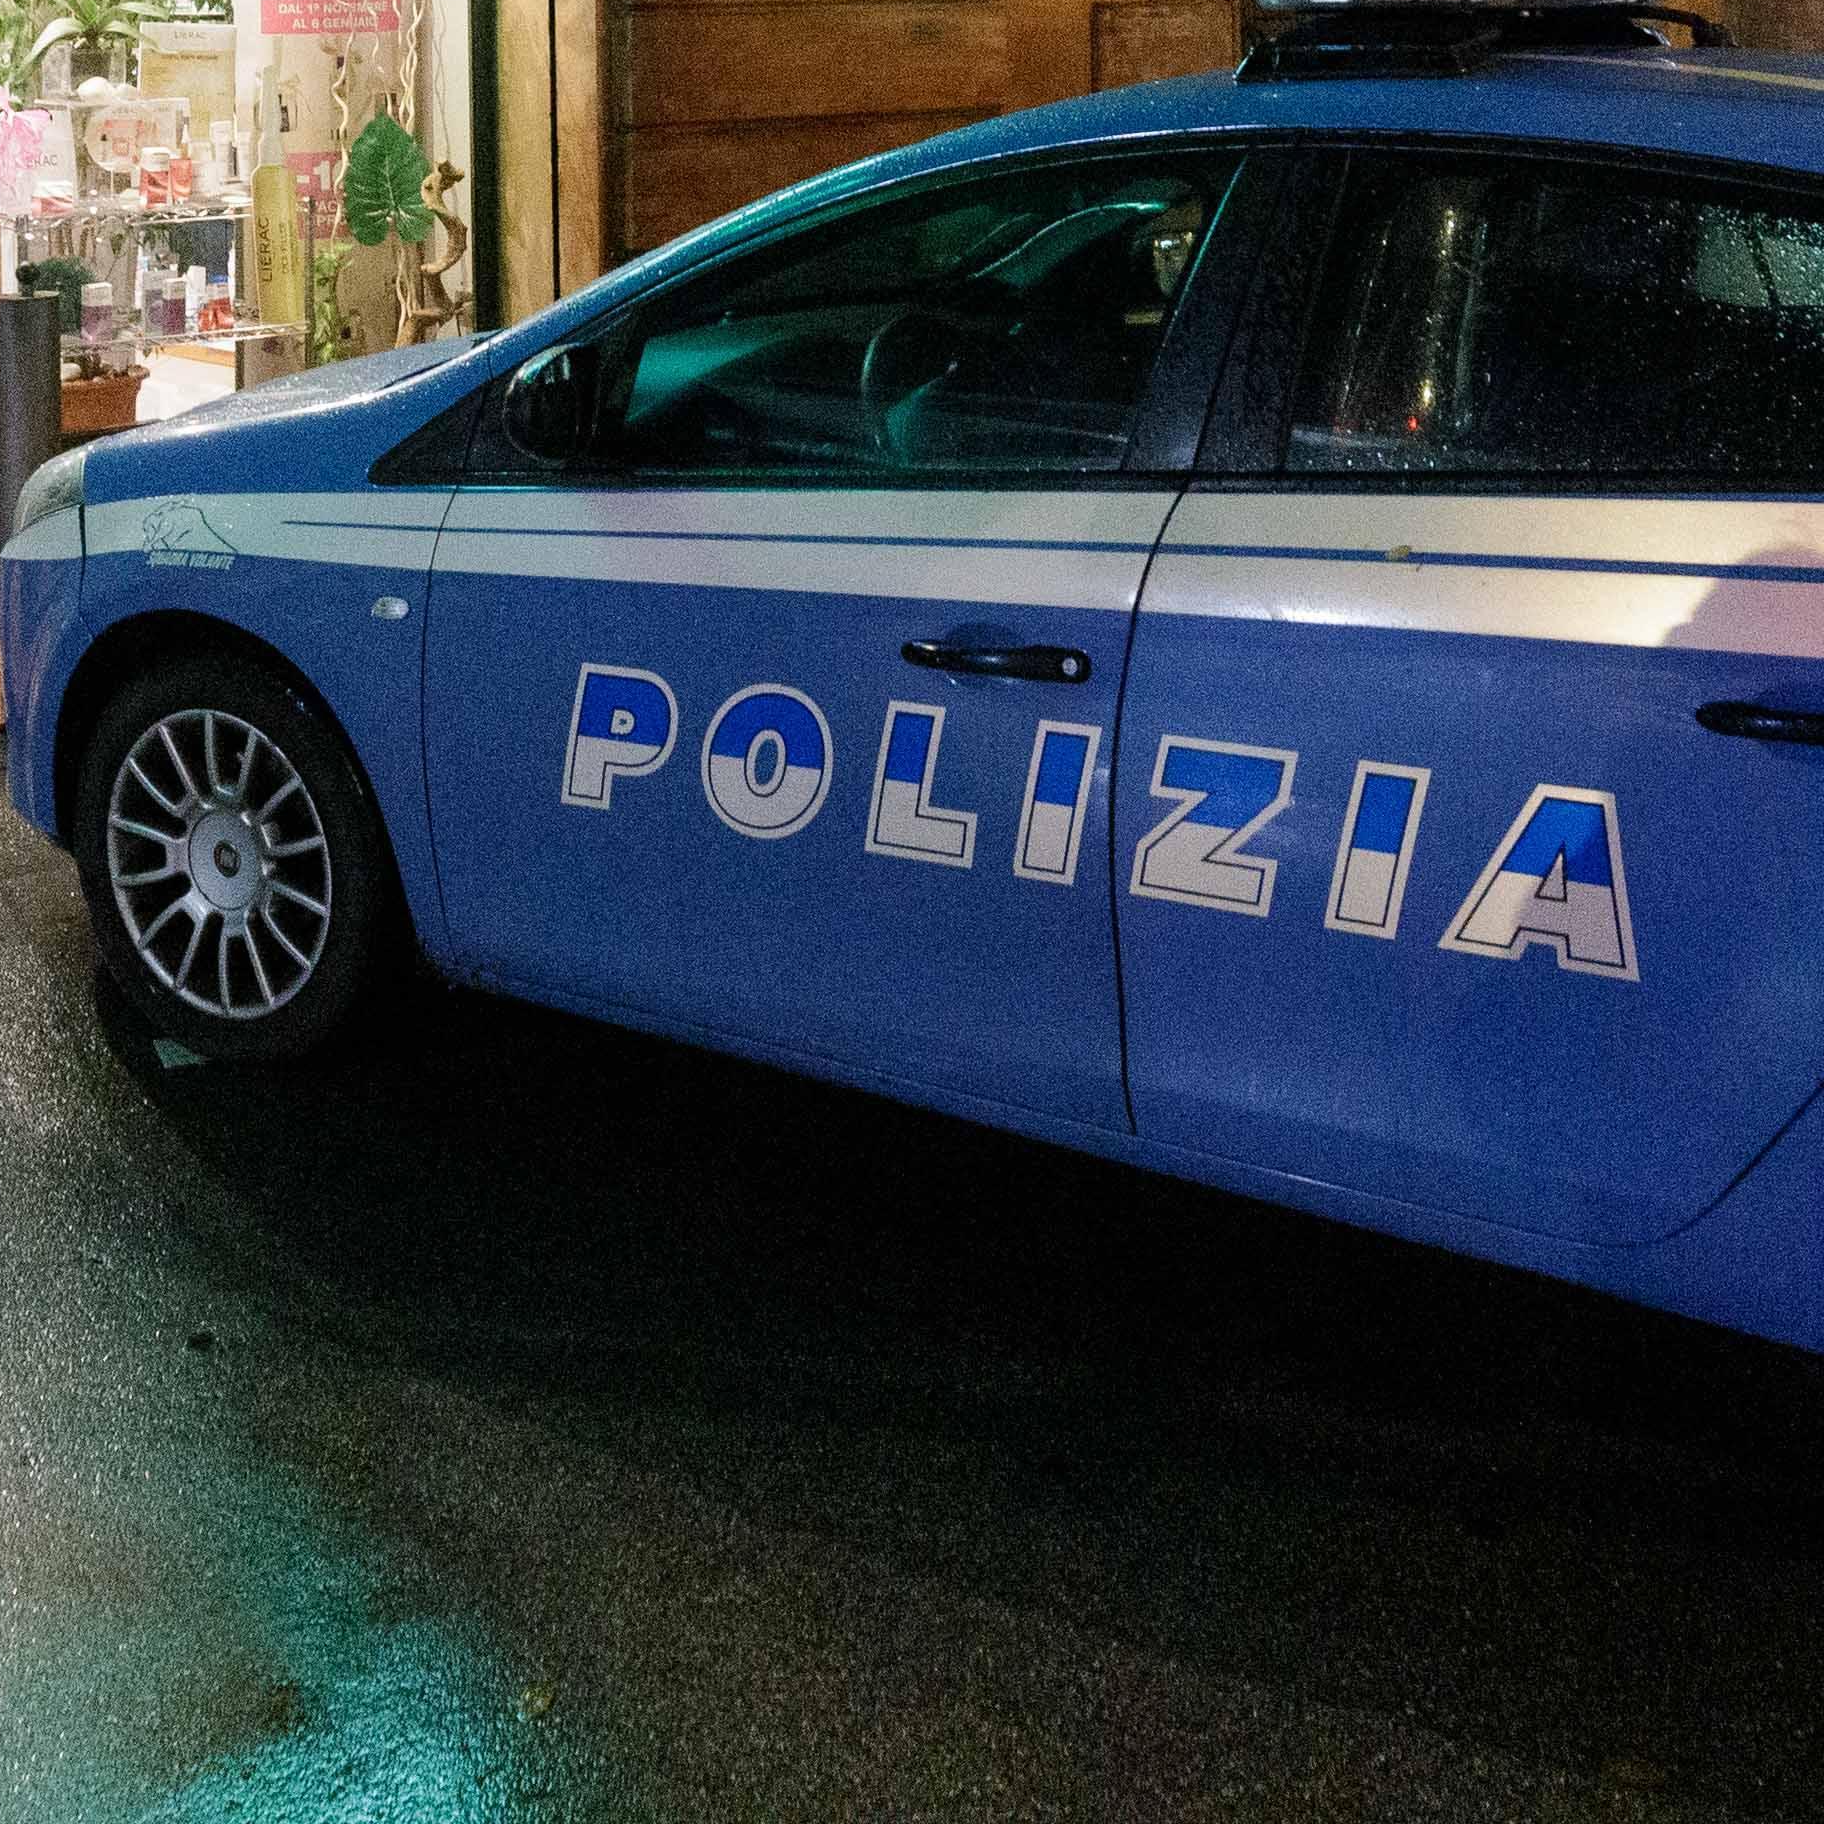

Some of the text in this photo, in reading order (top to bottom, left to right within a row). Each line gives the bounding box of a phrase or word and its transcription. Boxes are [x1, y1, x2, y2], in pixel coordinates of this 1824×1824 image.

[278, 3, 303, 14] DAL
[292, 18, 309, 29] AL
[257, 216, 273, 282] LIERAC
[560, 661, 1641, 982] POLIZIA
